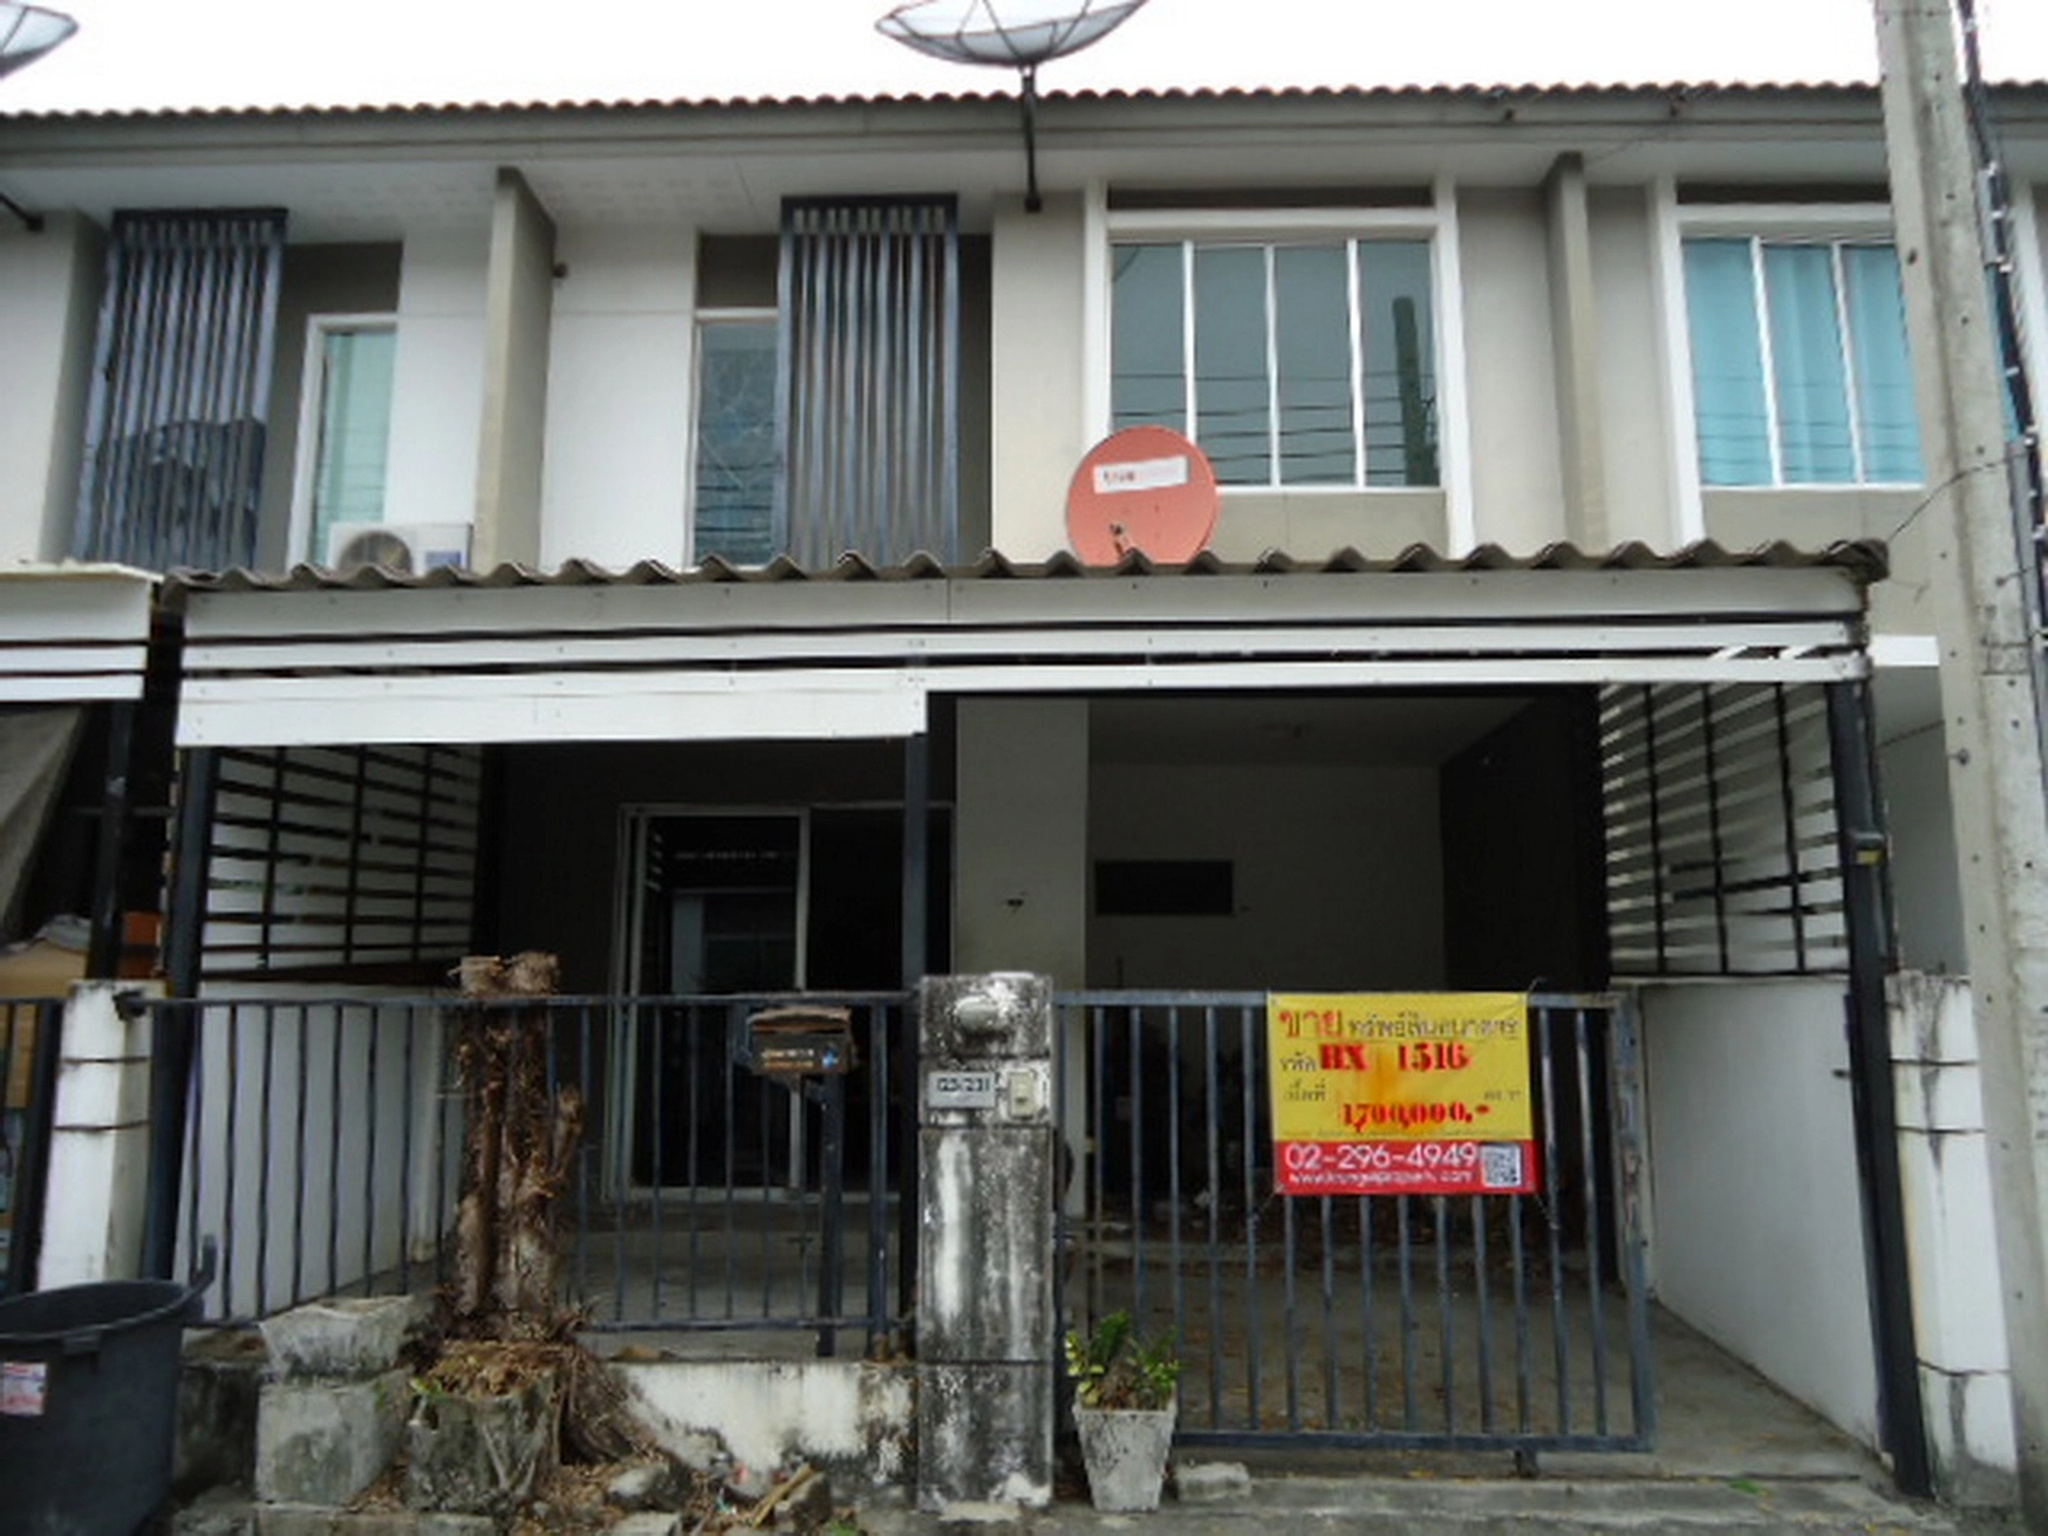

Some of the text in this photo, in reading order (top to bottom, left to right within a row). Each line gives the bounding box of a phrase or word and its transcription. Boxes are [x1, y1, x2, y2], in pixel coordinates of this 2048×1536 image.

[1279, 1010, 1342, 1038] ขาย
[1398, 1043, 1470, 1072] 1516
[1285, 1142, 1478, 1170] 02-296-4949
